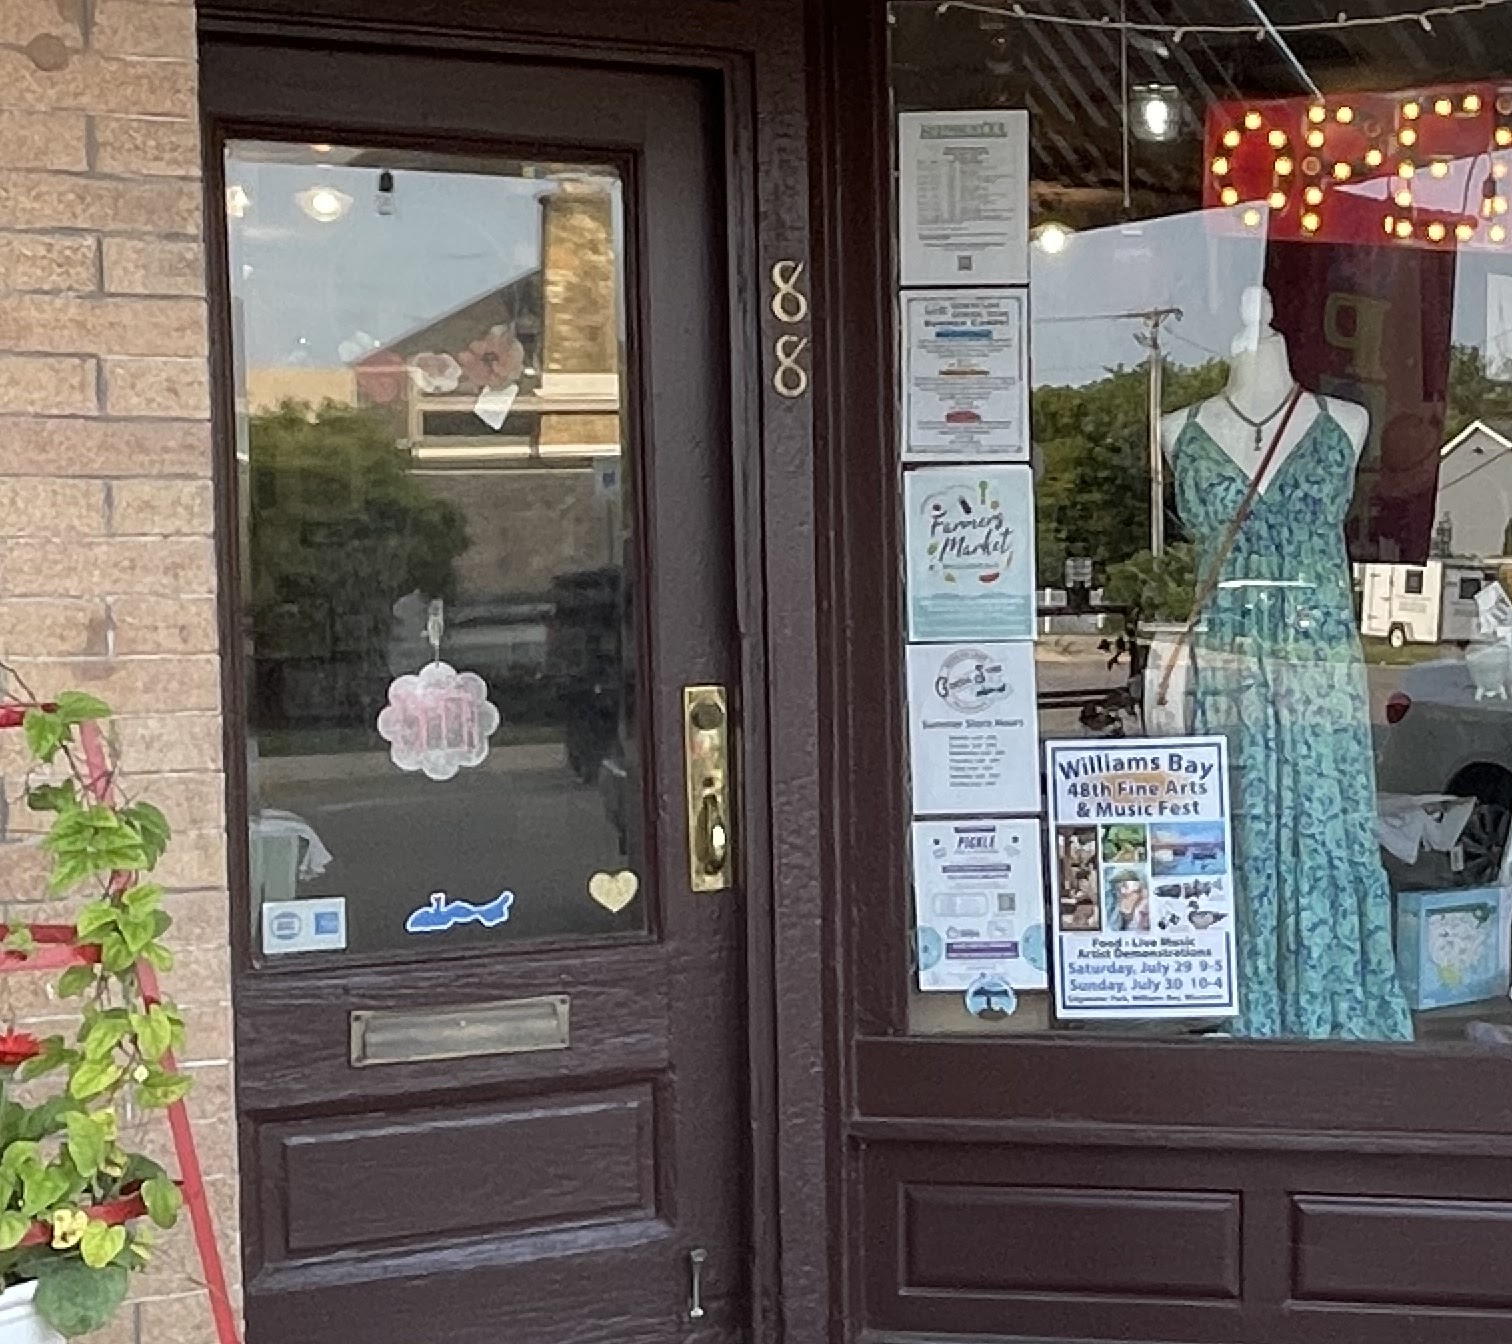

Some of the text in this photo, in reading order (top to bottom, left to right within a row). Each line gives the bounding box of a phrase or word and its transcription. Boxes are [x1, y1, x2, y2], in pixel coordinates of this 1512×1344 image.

[771, 259, 808, 398] 88
[937, 527, 1014, 562] Market
[1058, 752, 1214, 780] Williams Bay
[1067, 779, 1208, 798] 48th Fine Arts
[1076, 800, 1201, 818] & Music Fest
[1068, 959, 1223, 977] Saturday, July 29 9-5
[1070, 976, 1223, 993] Sunday, July 30 10-4
